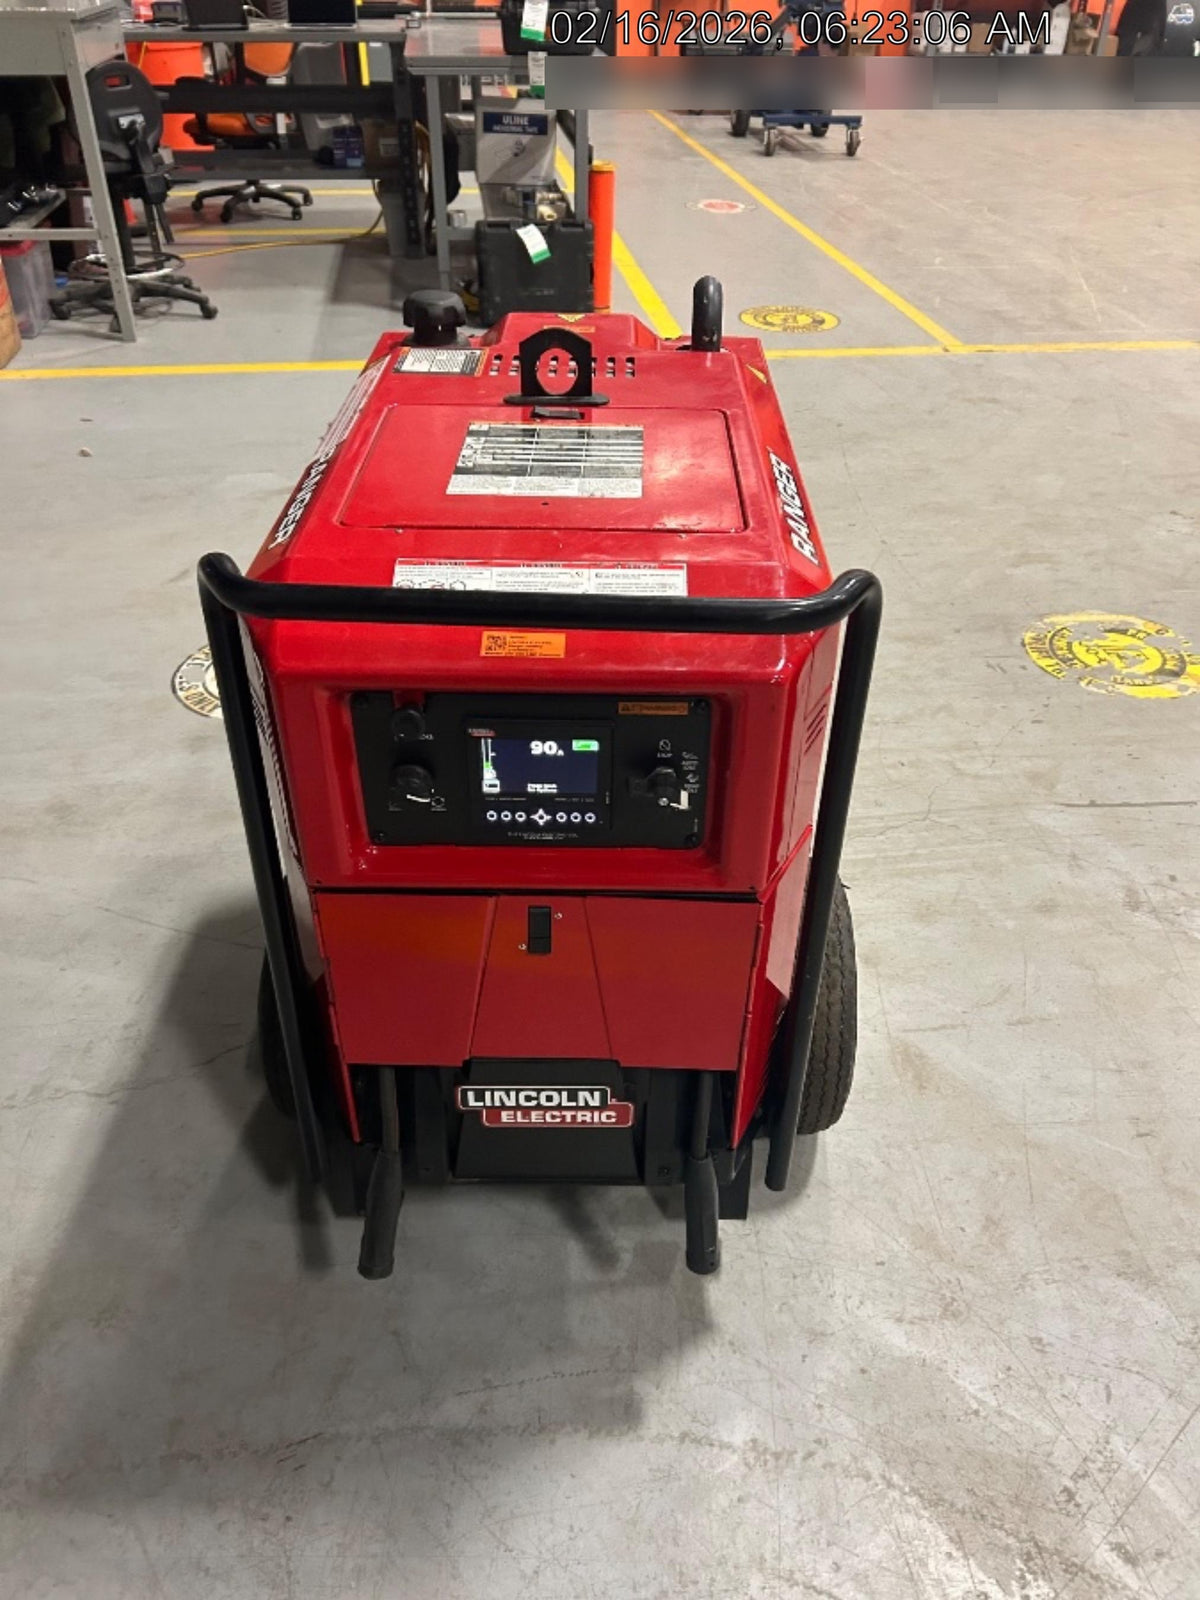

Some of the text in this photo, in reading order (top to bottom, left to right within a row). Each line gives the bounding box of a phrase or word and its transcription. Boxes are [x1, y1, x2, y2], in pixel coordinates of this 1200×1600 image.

[502, 115, 529, 125] ULINE
[268, 443, 339, 551] RANGER
[766, 445, 821, 567] RANGER
[466, 1090, 601, 1107] LINCOLN
[500, 1110, 618, 1123] ELECTRIC
